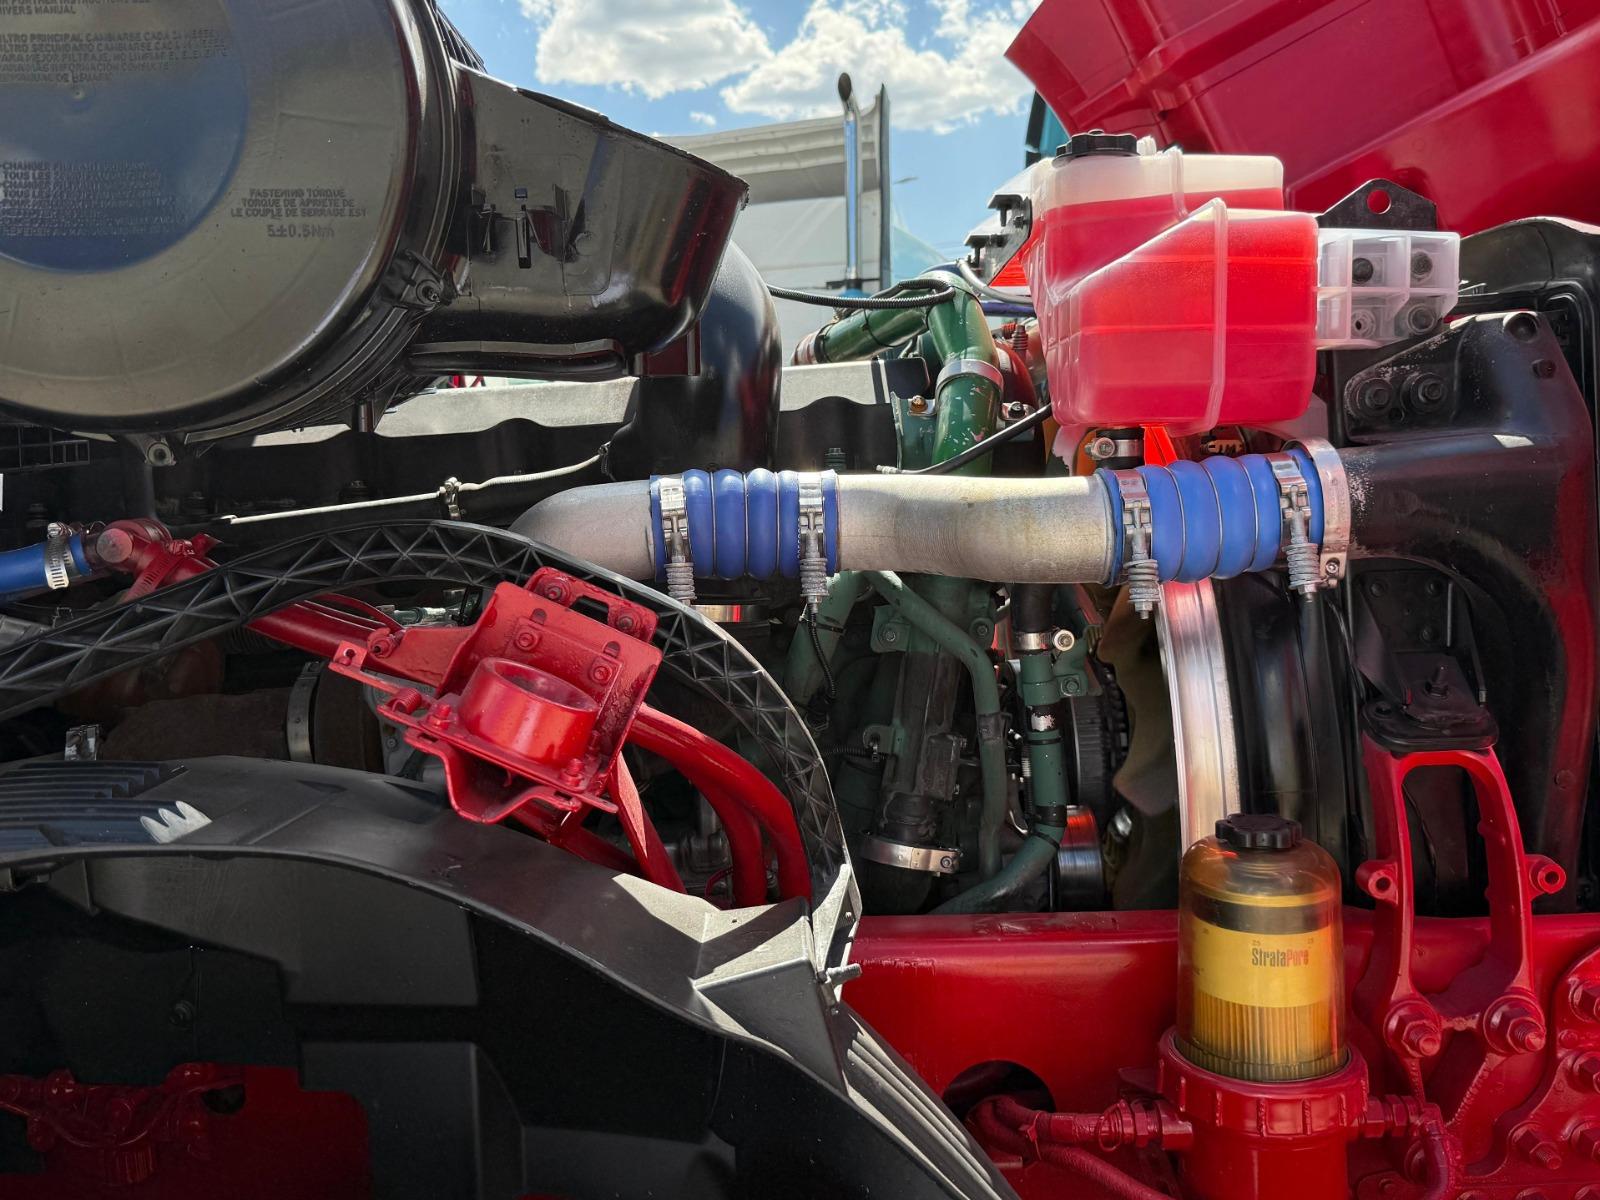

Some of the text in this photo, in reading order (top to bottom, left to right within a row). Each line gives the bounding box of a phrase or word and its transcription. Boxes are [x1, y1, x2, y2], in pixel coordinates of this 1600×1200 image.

[0, 5, 76, 15] IVERS MANUAL
[30, 33, 83, 42] PRINCIPAL
[0, 54, 24, 62] ARA
[249, 187, 346, 198] FASTENING TORQUE
[242, 198, 280, 208] TORQUE
[283, 199, 297, 208] DE
[342, 199, 355, 208] DE
[231, 208, 243, 217] LE
[245, 208, 283, 218] COUPLE
[285, 208, 299, 217] DE
[1252, 948, 1309, 967] StrataPore
